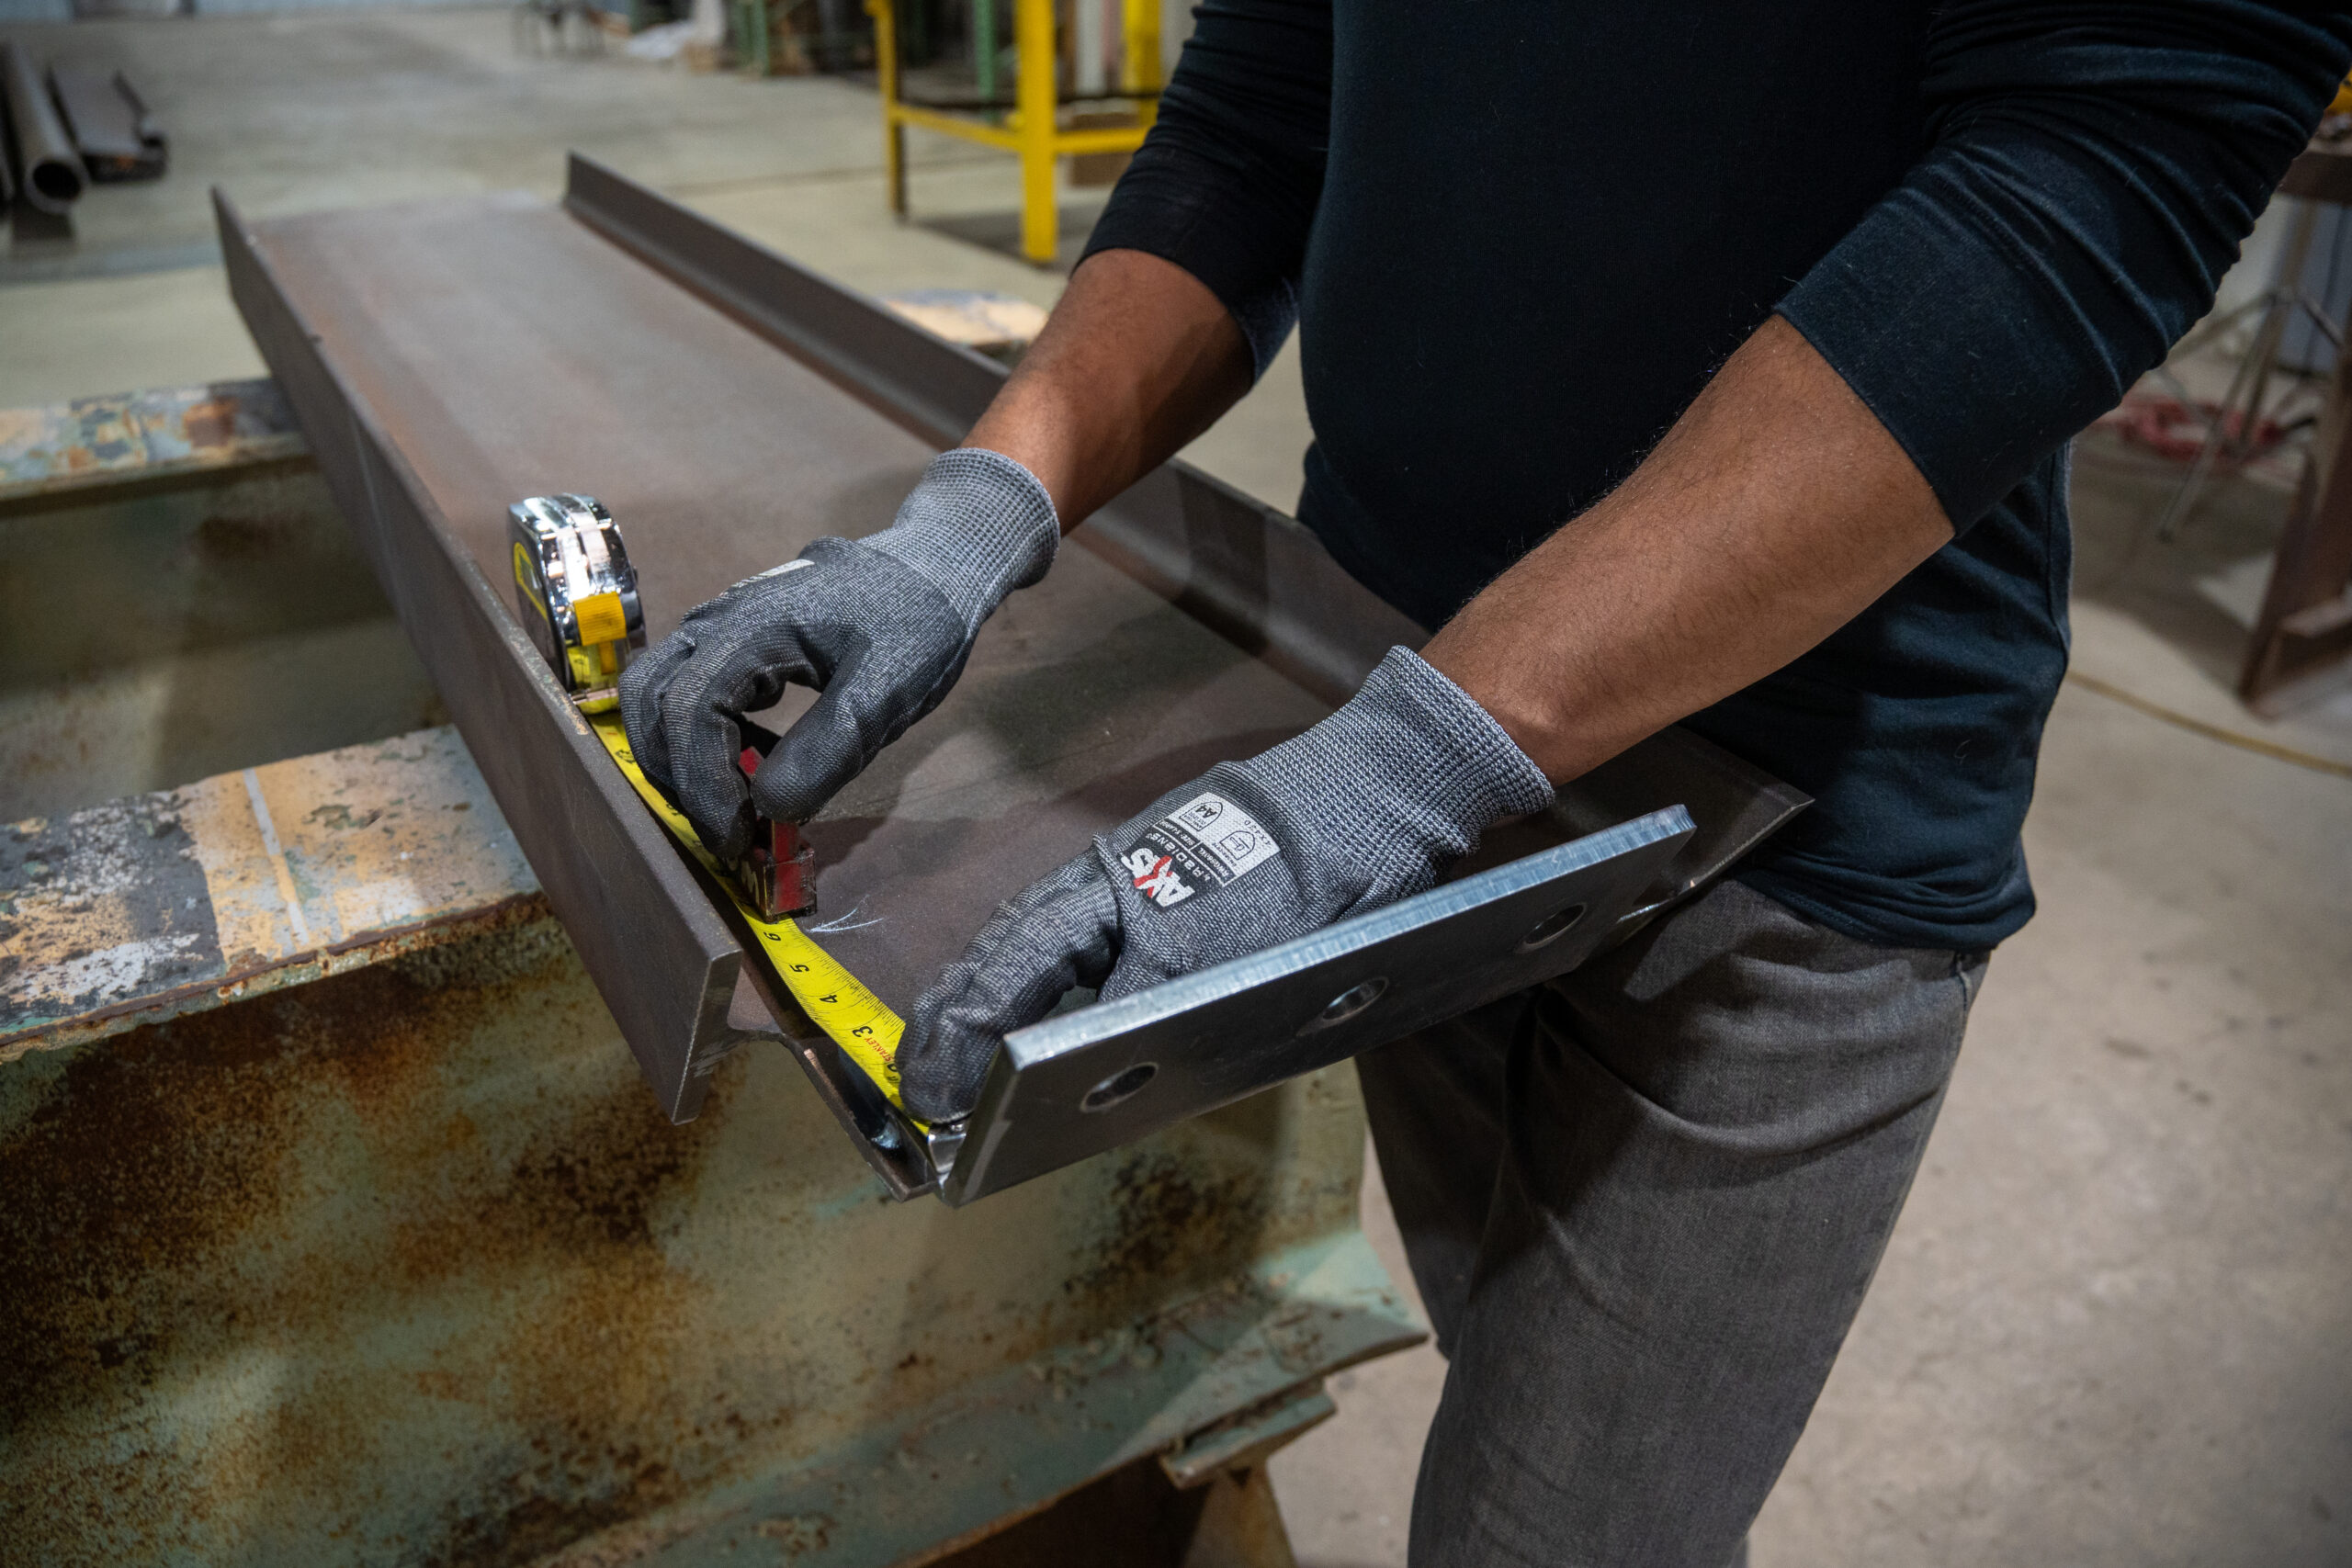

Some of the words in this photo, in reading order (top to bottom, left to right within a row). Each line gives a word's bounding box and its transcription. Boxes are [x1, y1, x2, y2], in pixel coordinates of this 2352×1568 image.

[1195, 805, 1217, 818] A4
[763, 931, 781, 942] 6
[789, 964, 809, 973] 5
[820, 995, 838, 1003] 4
[853, 1026, 873, 1037] 3
[865, 1037, 895, 1063] STANLEY
